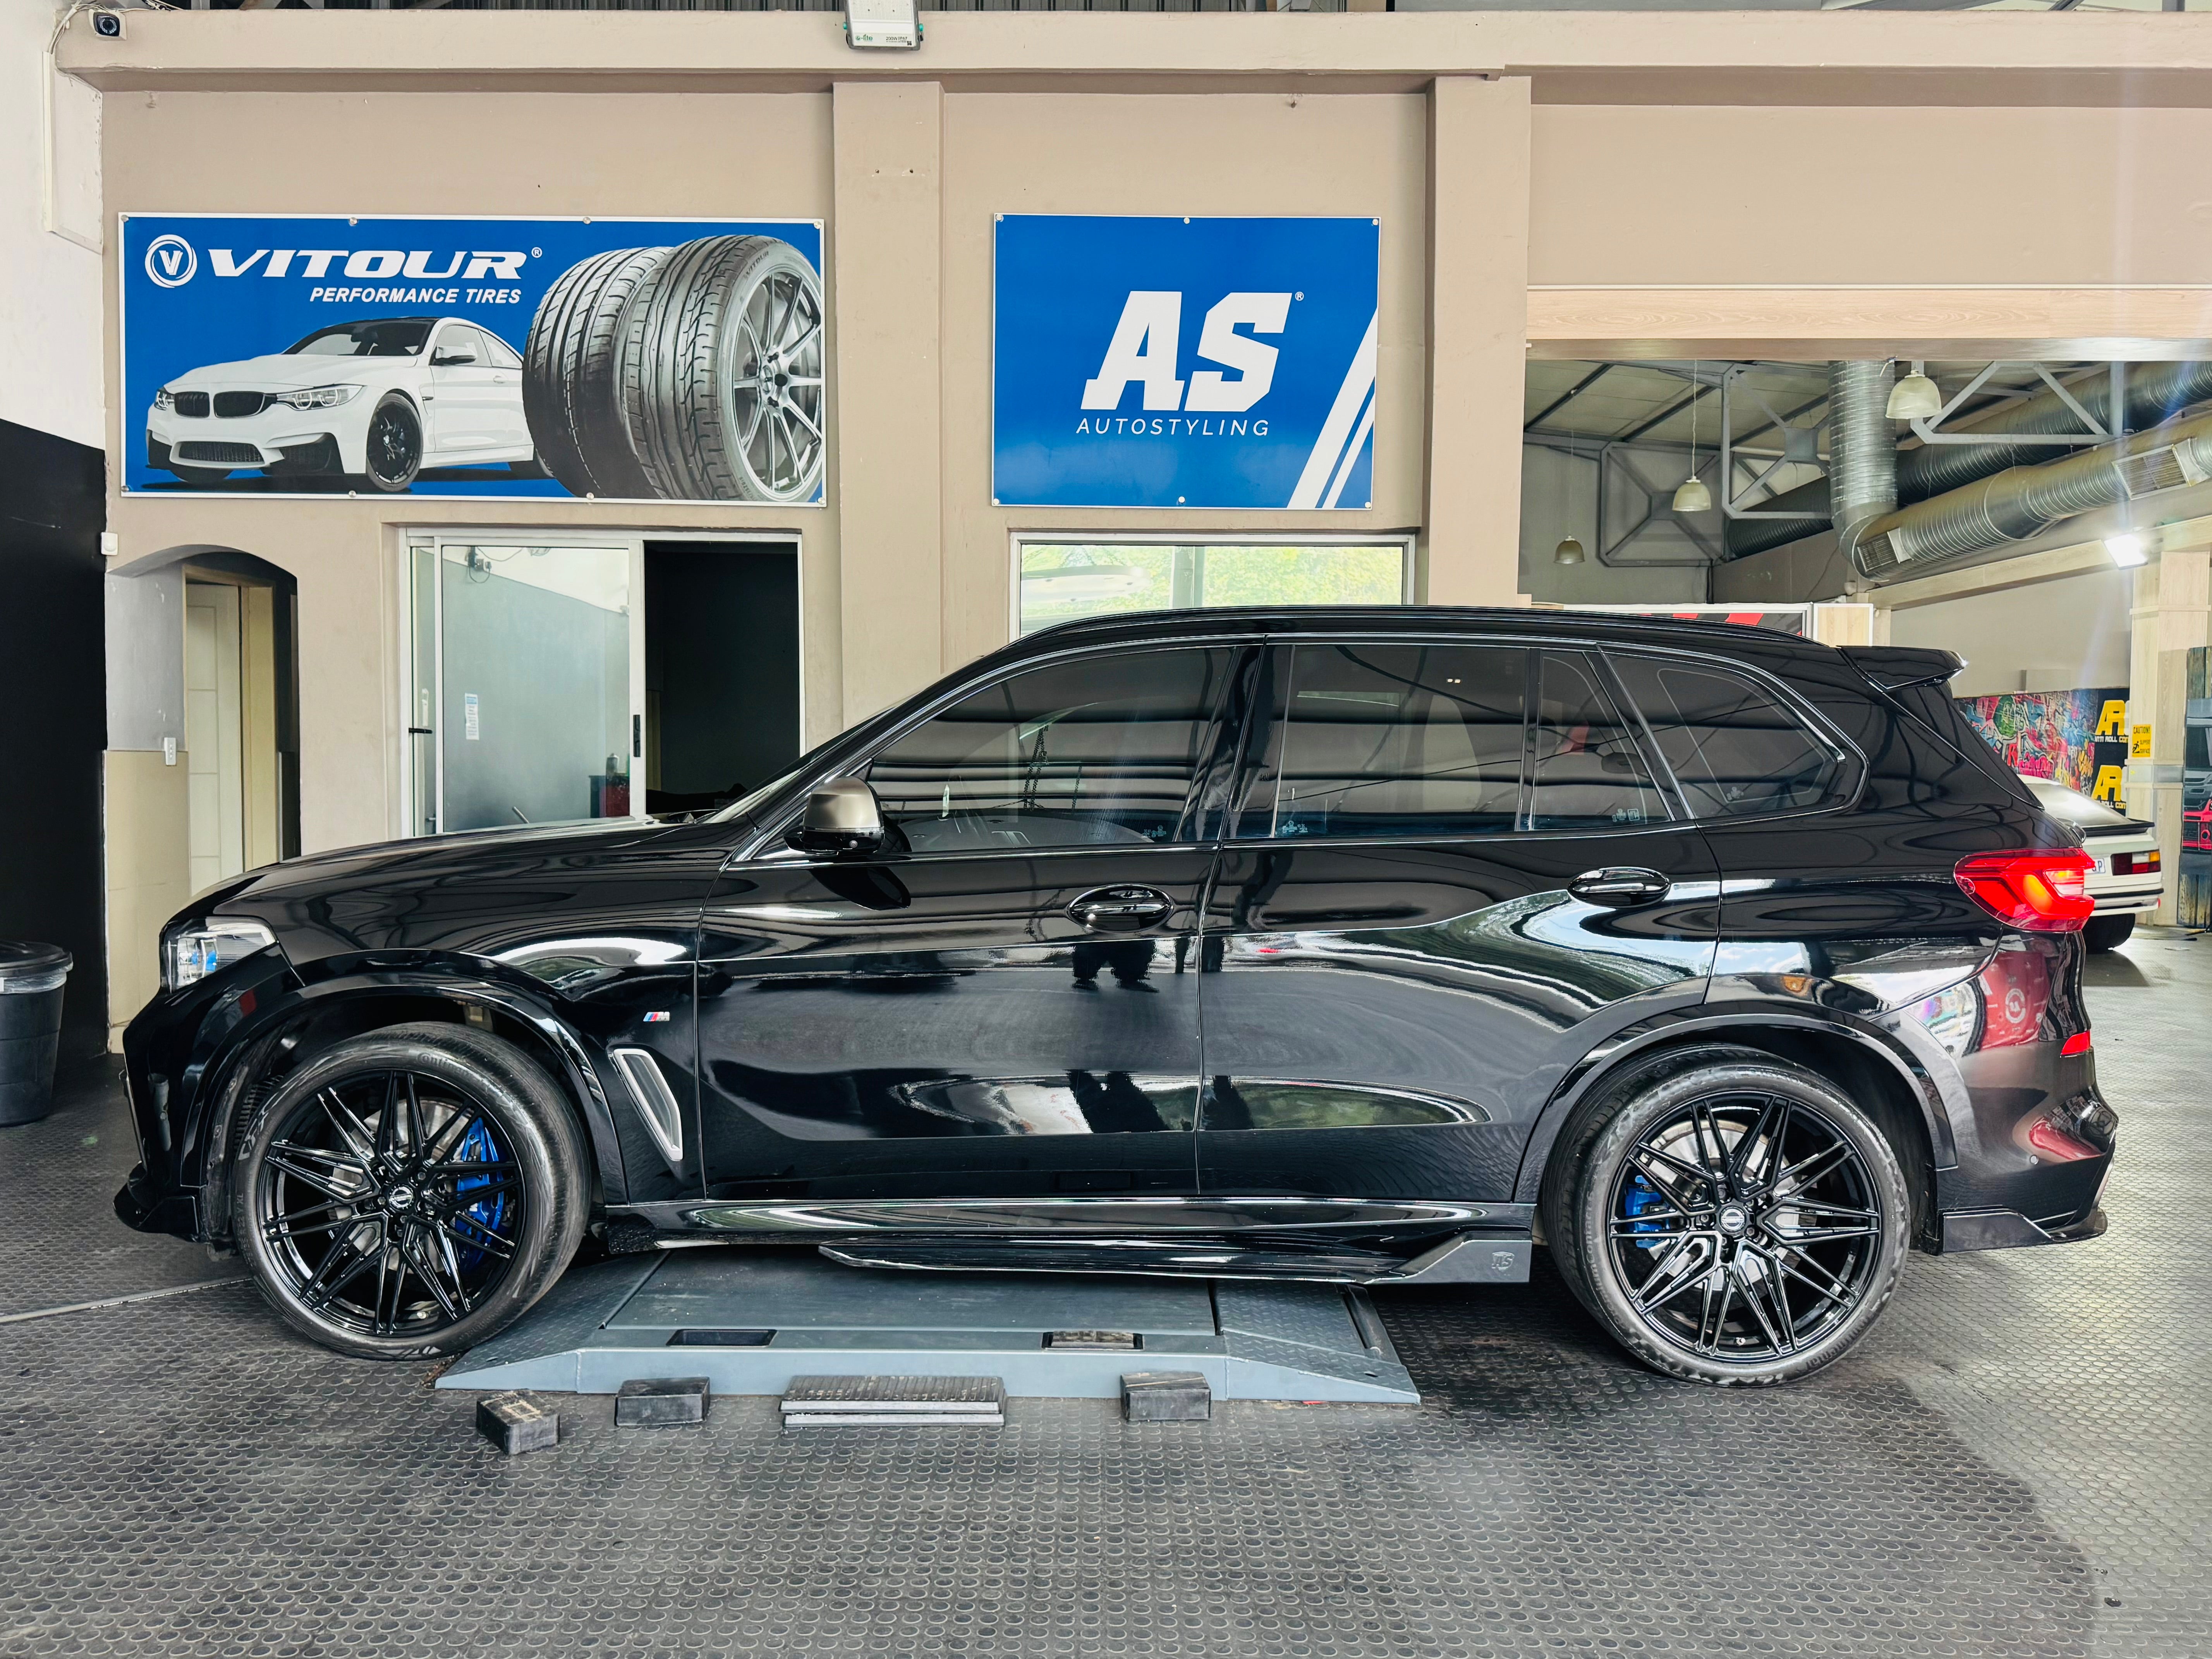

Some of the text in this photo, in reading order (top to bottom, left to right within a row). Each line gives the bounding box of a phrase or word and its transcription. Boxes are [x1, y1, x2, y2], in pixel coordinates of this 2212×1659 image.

[208, 249, 527, 279] VITOUR
[310, 287, 521, 304] PERFORMANCE TIRES
[1080, 291, 1292, 412] AS
[1076, 418, 1268, 436] AUTOSTYLING
[237, 1192, 244, 1204] XL
